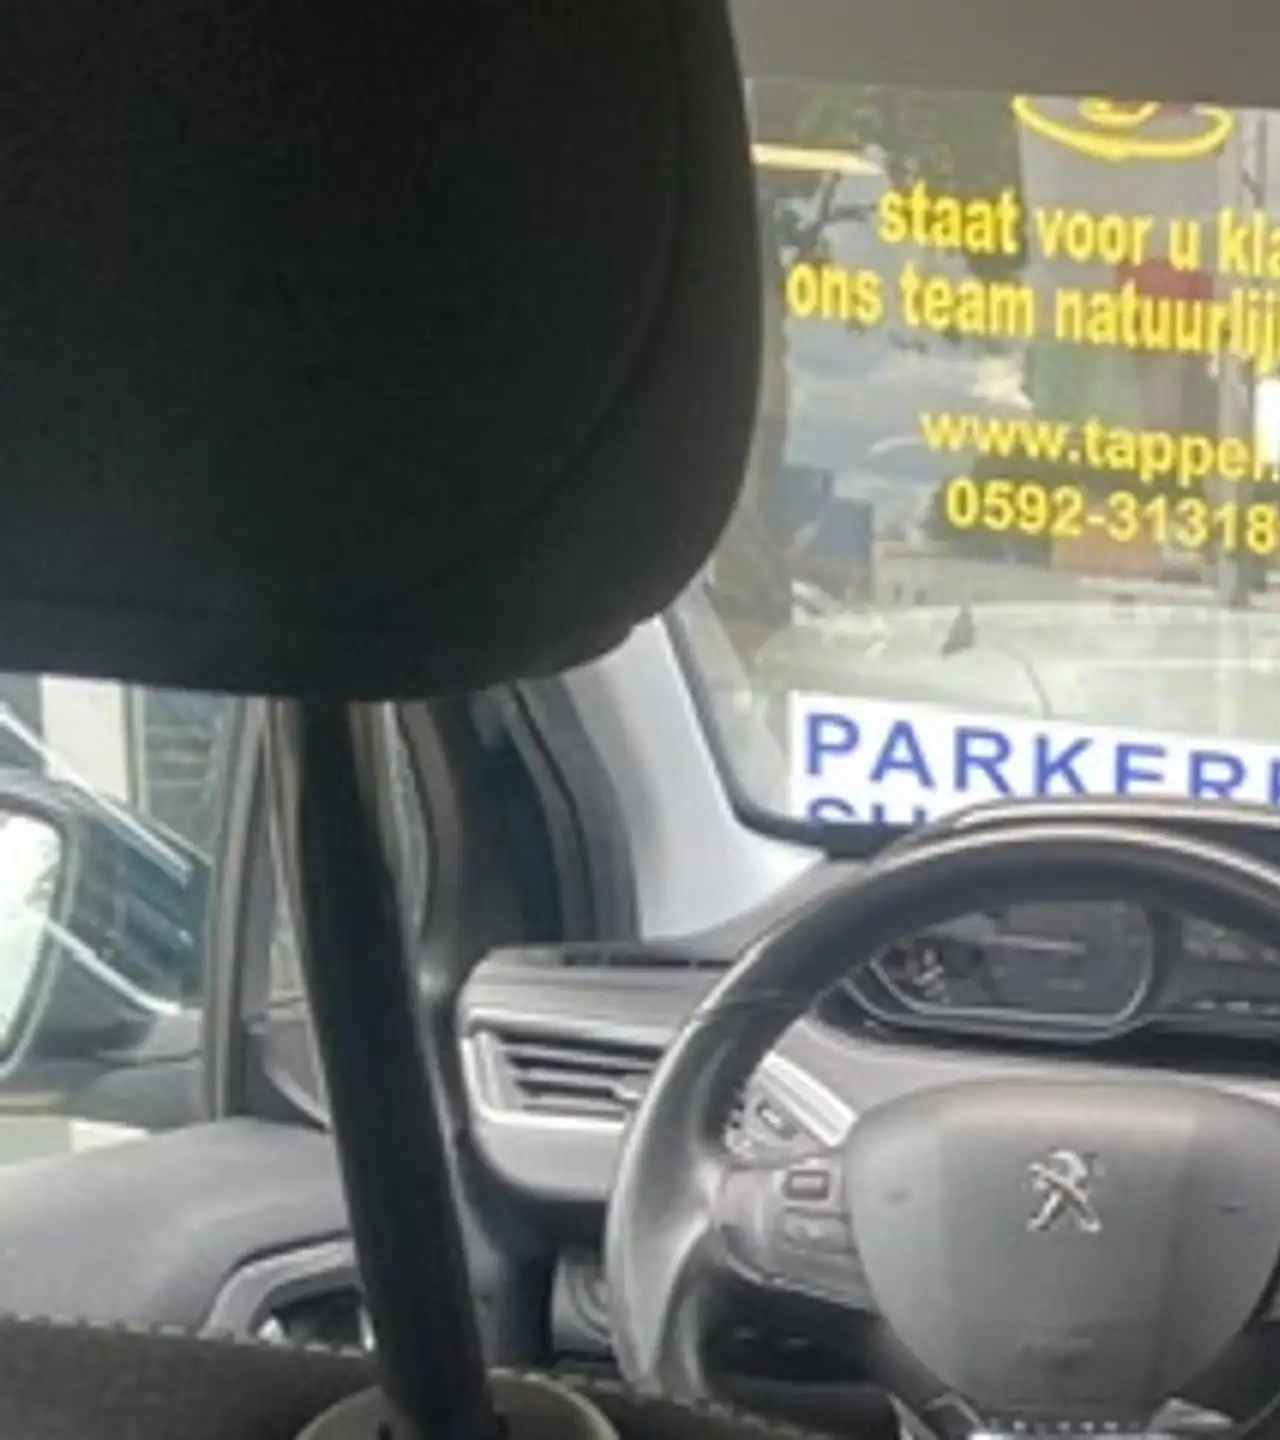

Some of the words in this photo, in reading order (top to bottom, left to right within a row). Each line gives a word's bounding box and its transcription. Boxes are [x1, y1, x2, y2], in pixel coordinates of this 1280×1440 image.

[878, 178, 1021, 255] staat
[1034, 206, 1154, 265] voor
[1168, 215, 1201, 273] u
[786, 261, 883, 326] ons
[899, 261, 1035, 339] team
